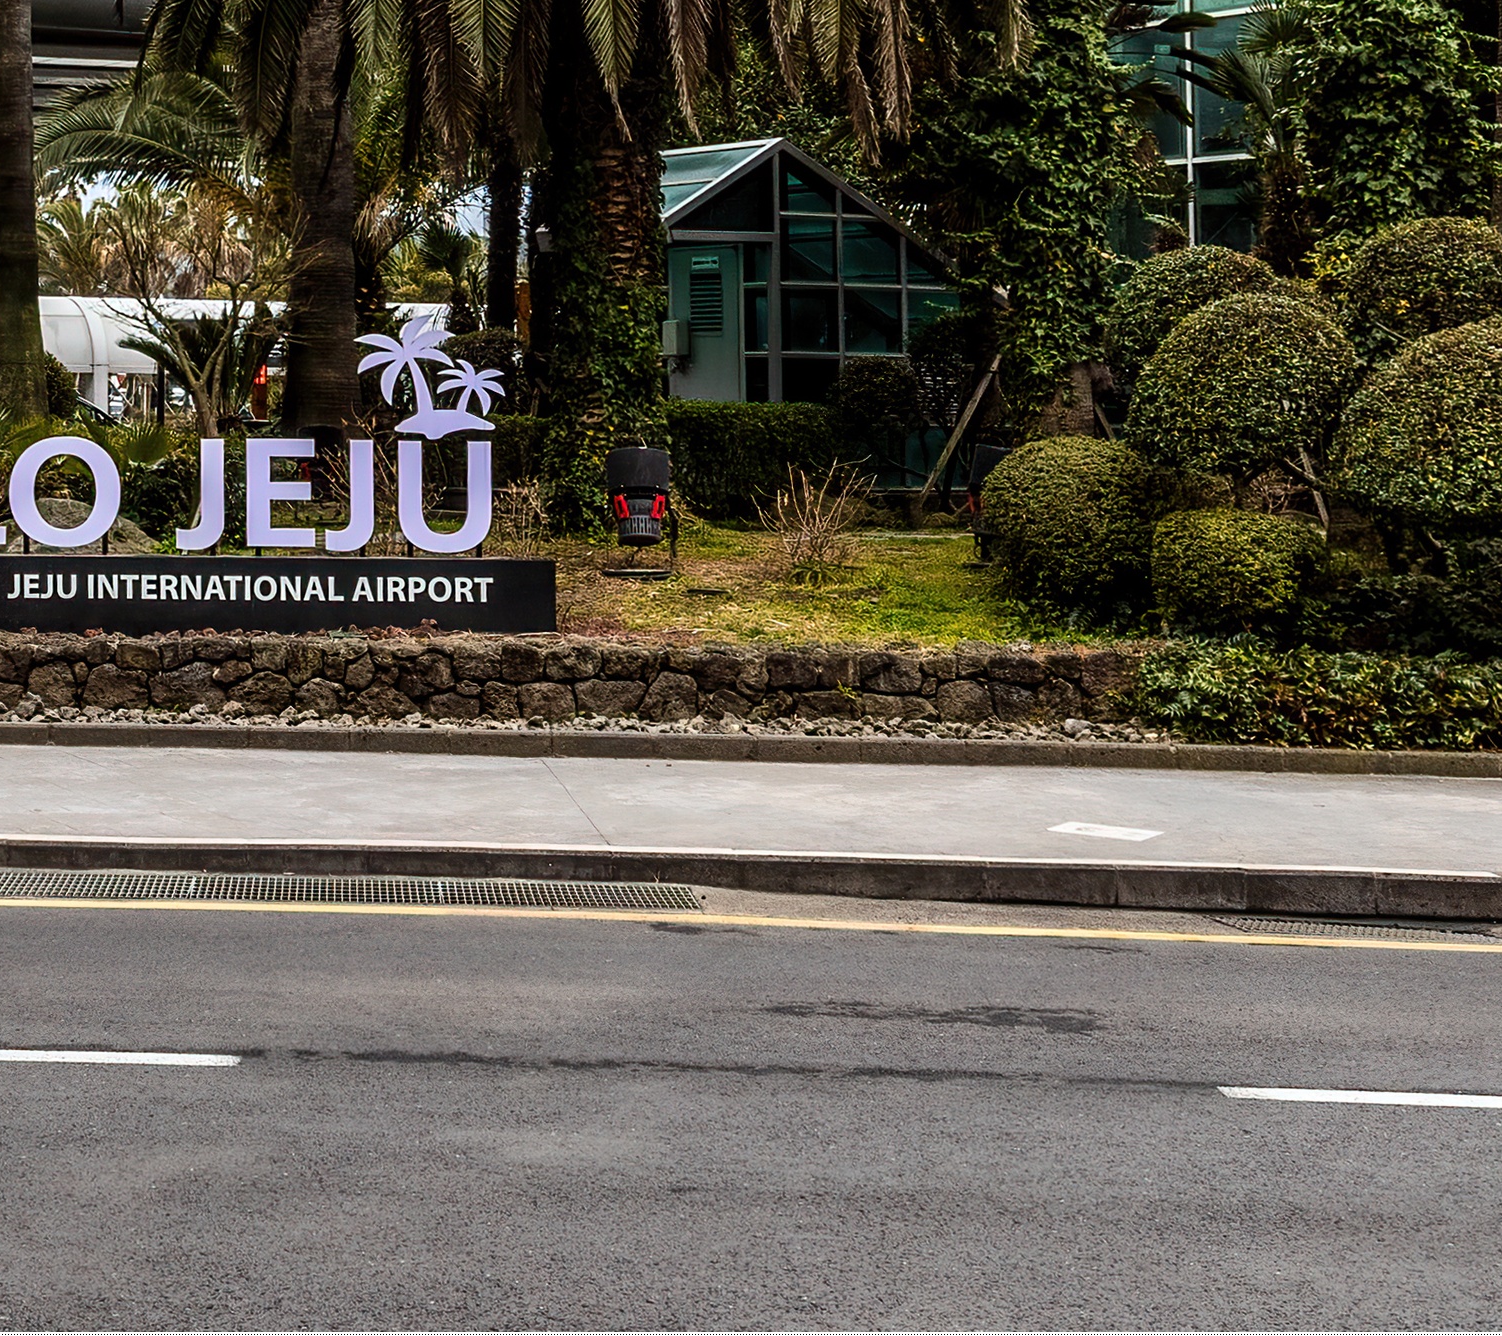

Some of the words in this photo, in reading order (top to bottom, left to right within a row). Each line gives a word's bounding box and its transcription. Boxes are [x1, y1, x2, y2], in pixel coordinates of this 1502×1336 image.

[175, 438, 493, 554] JEJU
[6, 573, 77, 600] JEJU
[87, 573, 344, 601] INTERNATIONAL
[351, 576, 493, 602] AIRPORT
